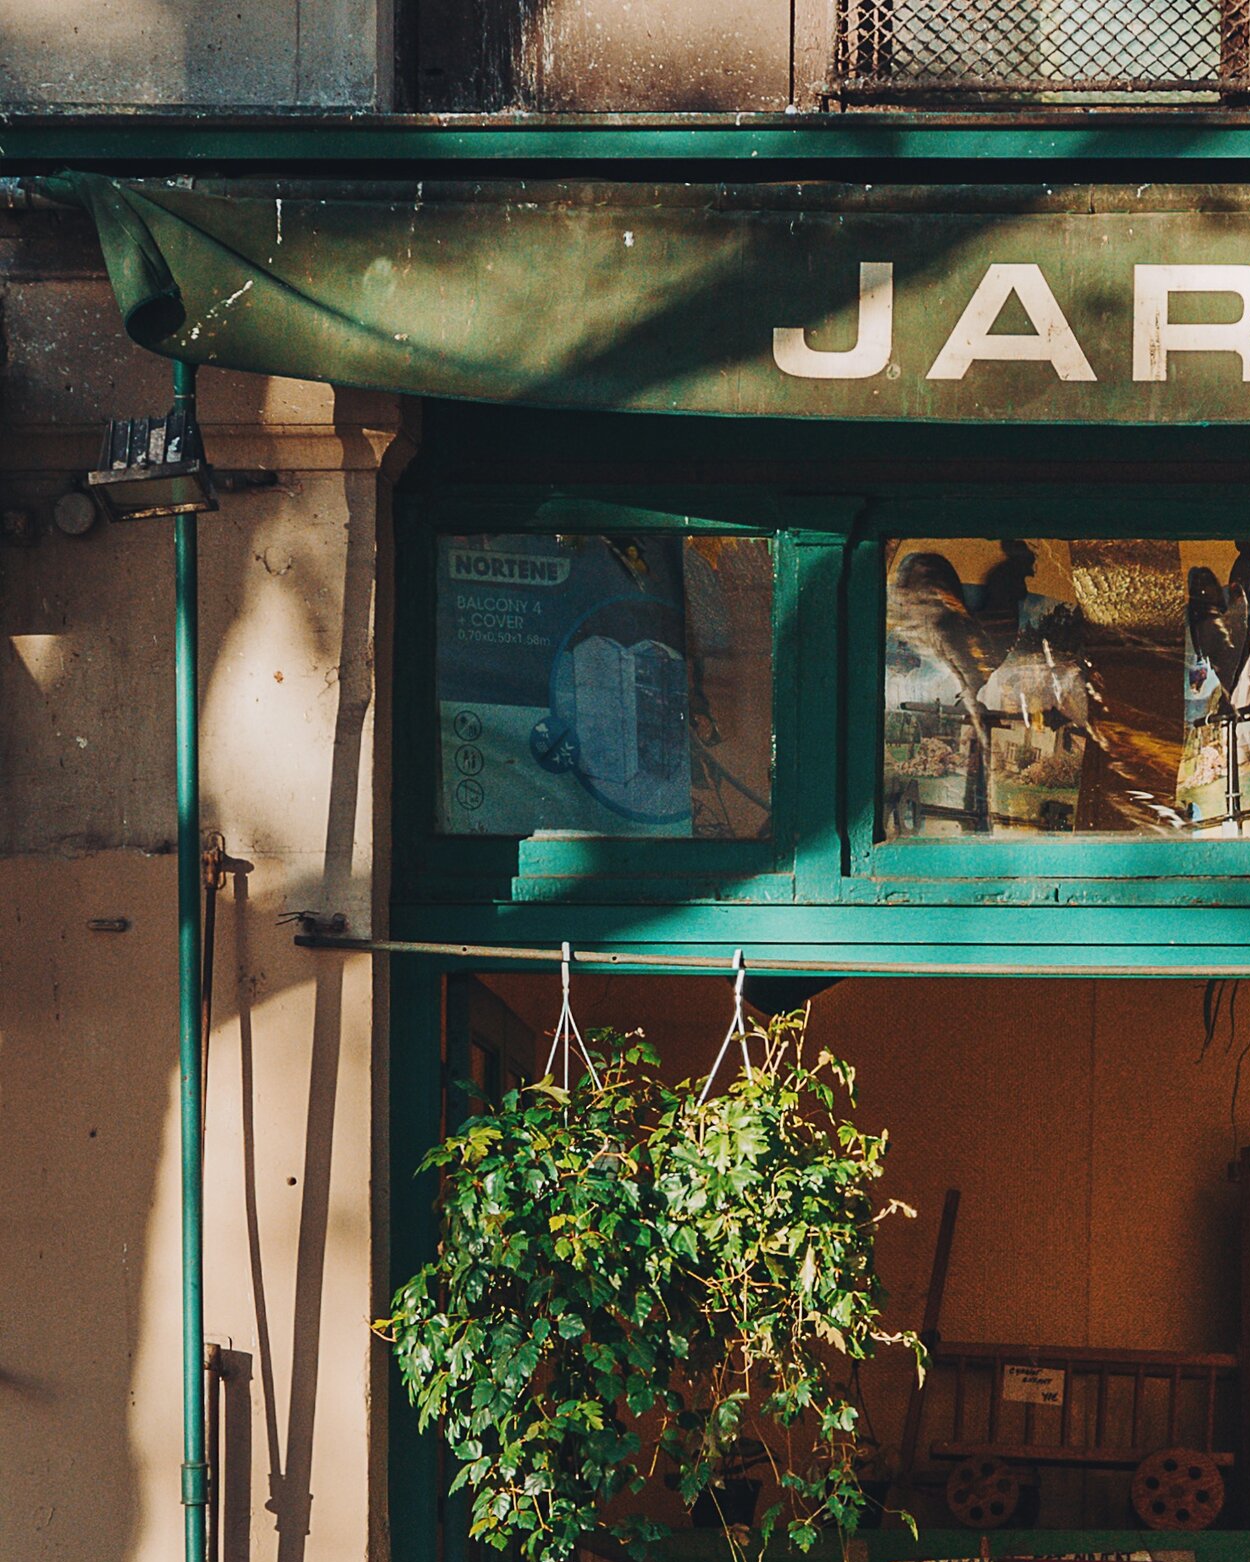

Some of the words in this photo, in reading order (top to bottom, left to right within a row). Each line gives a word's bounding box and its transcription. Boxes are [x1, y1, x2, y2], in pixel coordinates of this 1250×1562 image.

[455, 555, 559, 581] NORTENE
[457, 595, 528, 614] BALCONY
[532, 601, 543, 615] 4
[471, 612, 524, 629] COVER
